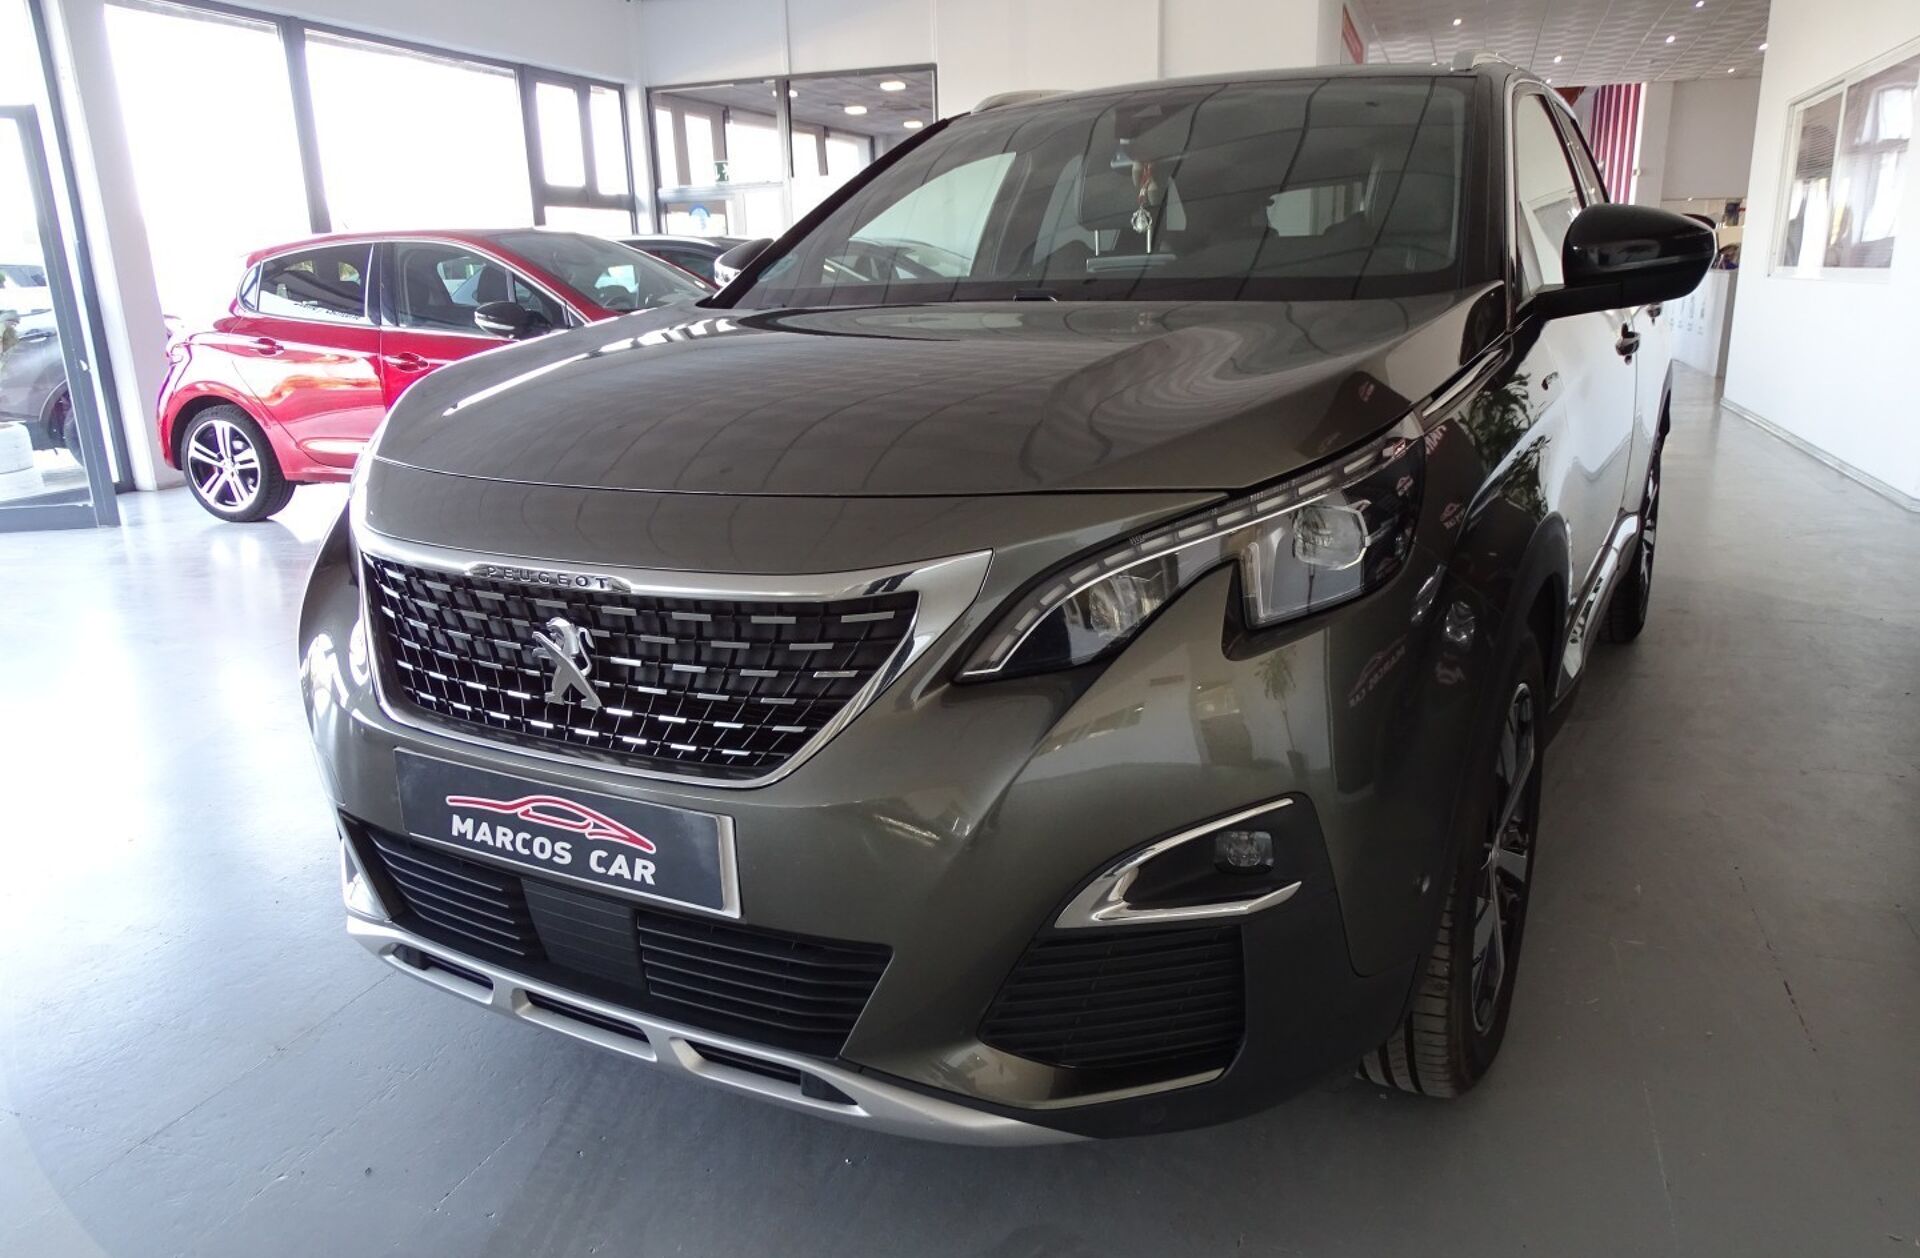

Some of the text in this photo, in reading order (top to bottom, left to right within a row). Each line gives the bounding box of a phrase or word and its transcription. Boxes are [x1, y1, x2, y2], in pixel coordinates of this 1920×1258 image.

[486, 565, 607, 589] PEUGEOT
[451, 814, 657, 885] MARCOS CAR
